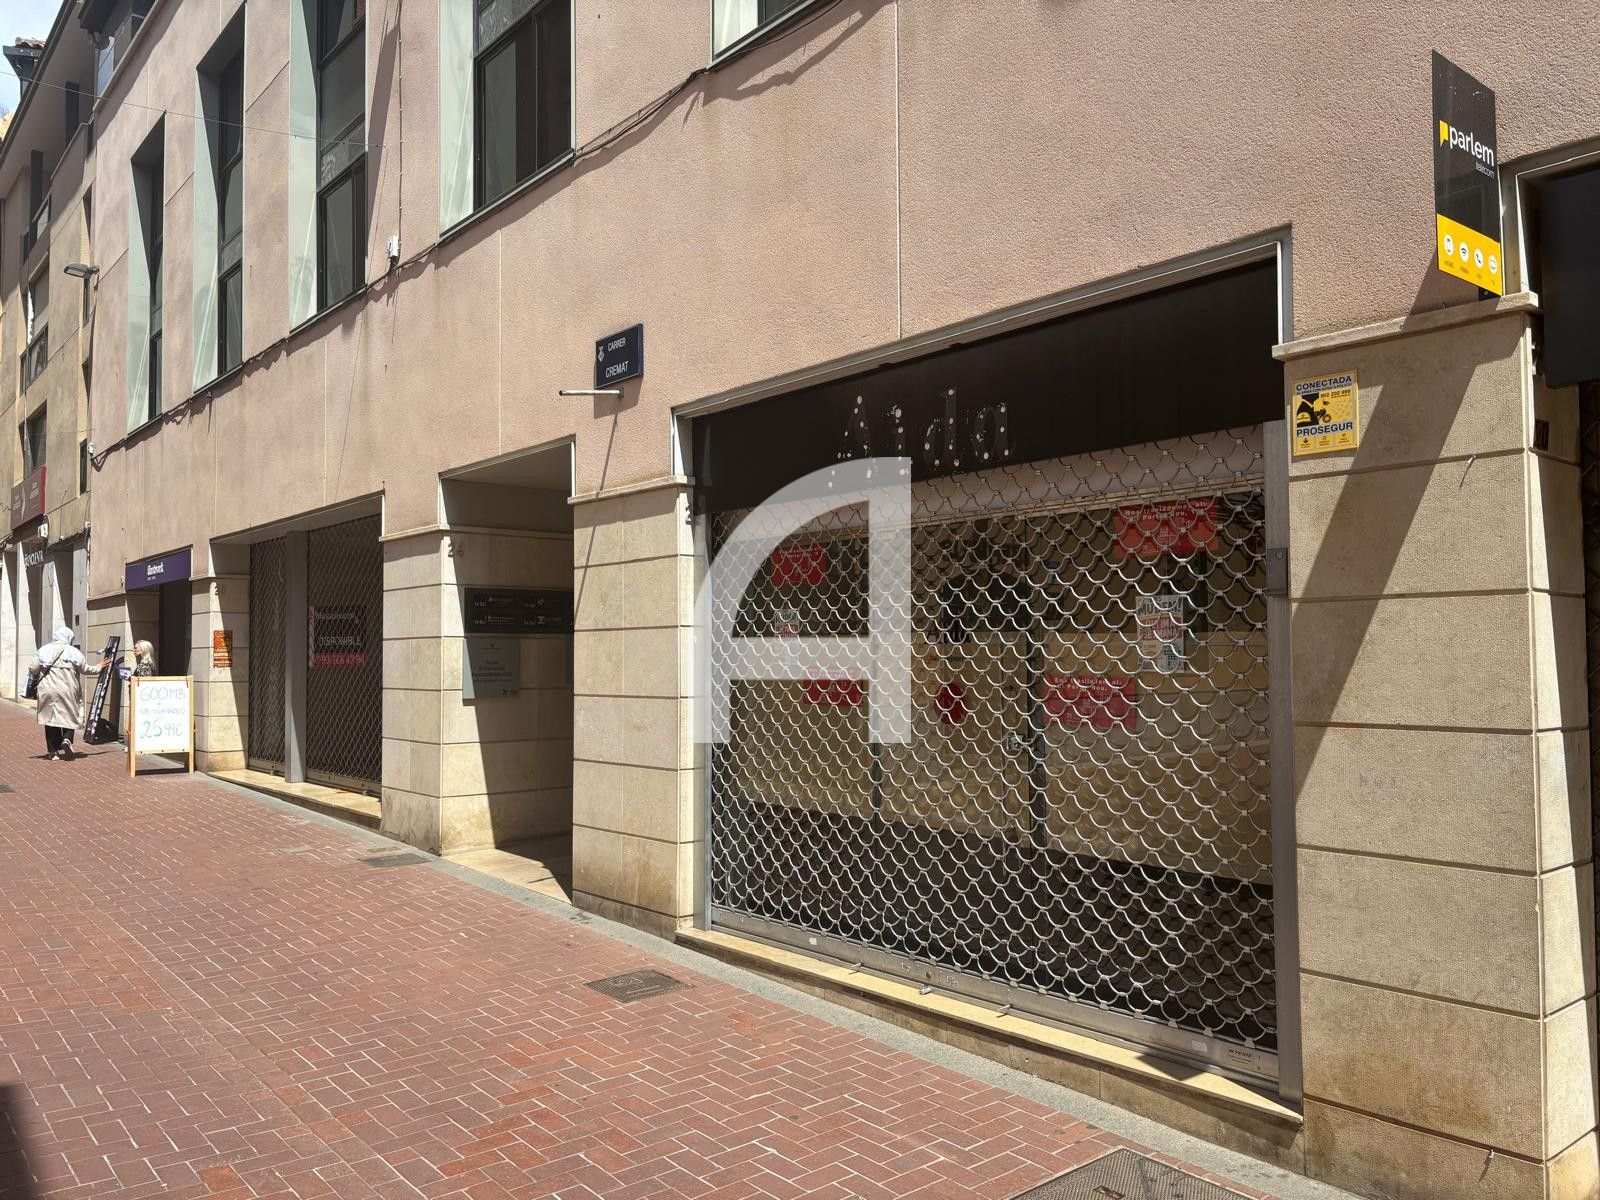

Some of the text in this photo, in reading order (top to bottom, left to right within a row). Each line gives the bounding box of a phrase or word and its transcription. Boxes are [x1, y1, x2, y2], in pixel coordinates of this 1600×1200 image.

[1449, 125, 1495, 167] parlem
[607, 337, 626, 352] CARRER
[605, 360, 629, 378] CREMAT
[1296, 376, 1352, 391] CONECTADA
[1296, 421, 1353, 437] PROSEGUR
